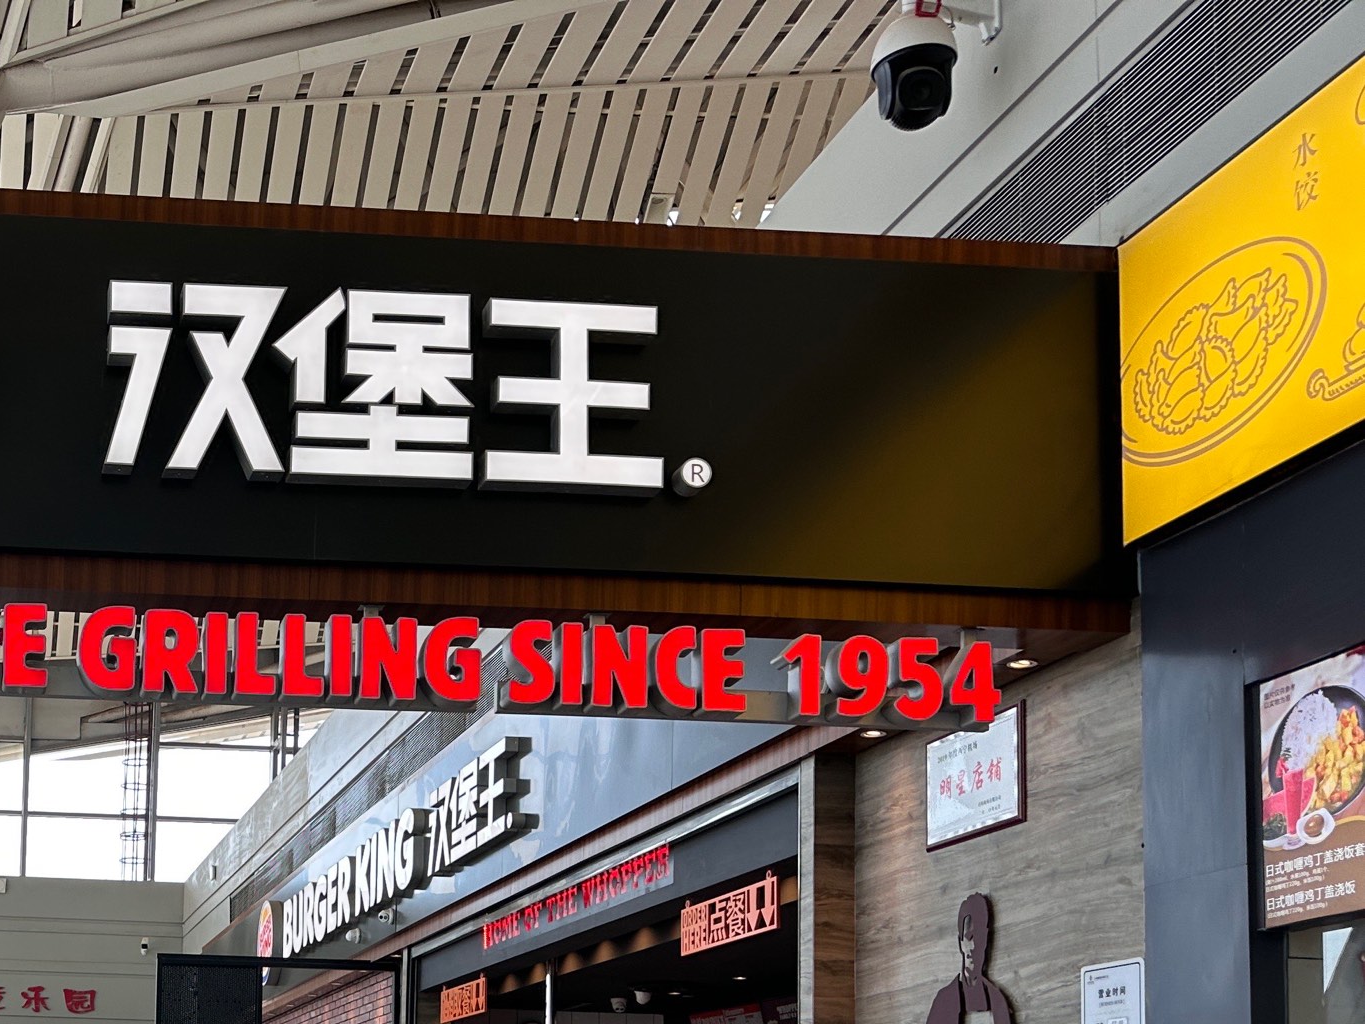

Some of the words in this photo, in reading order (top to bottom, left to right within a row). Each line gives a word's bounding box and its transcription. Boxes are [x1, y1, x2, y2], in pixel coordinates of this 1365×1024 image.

[1292, 132, 1319, 212] 水饺
[102, 279, 665, 487] 汉堡王
[78, 604, 482, 701] GRILLING
[507, 619, 747, 712] SINCE
[781, 633, 1002, 722] 1954
[427, 737, 519, 877] 汉堡王
[939, 757, 1002, 799] 明星店铺
[283, 856, 352, 958] BURGER
[355, 807, 413, 916] KING
[482, 912, 521, 949] HOME
[523, 901, 543, 932] OF
[546, 886, 578, 923] THE
[581, 843, 671, 909] WHOPPER
[683, 904, 707, 928] ORDER
[709, 891, 745, 943] 点餐
[683, 924, 707, 953] HERE
[1098, 986, 1126, 998] 营业时间
